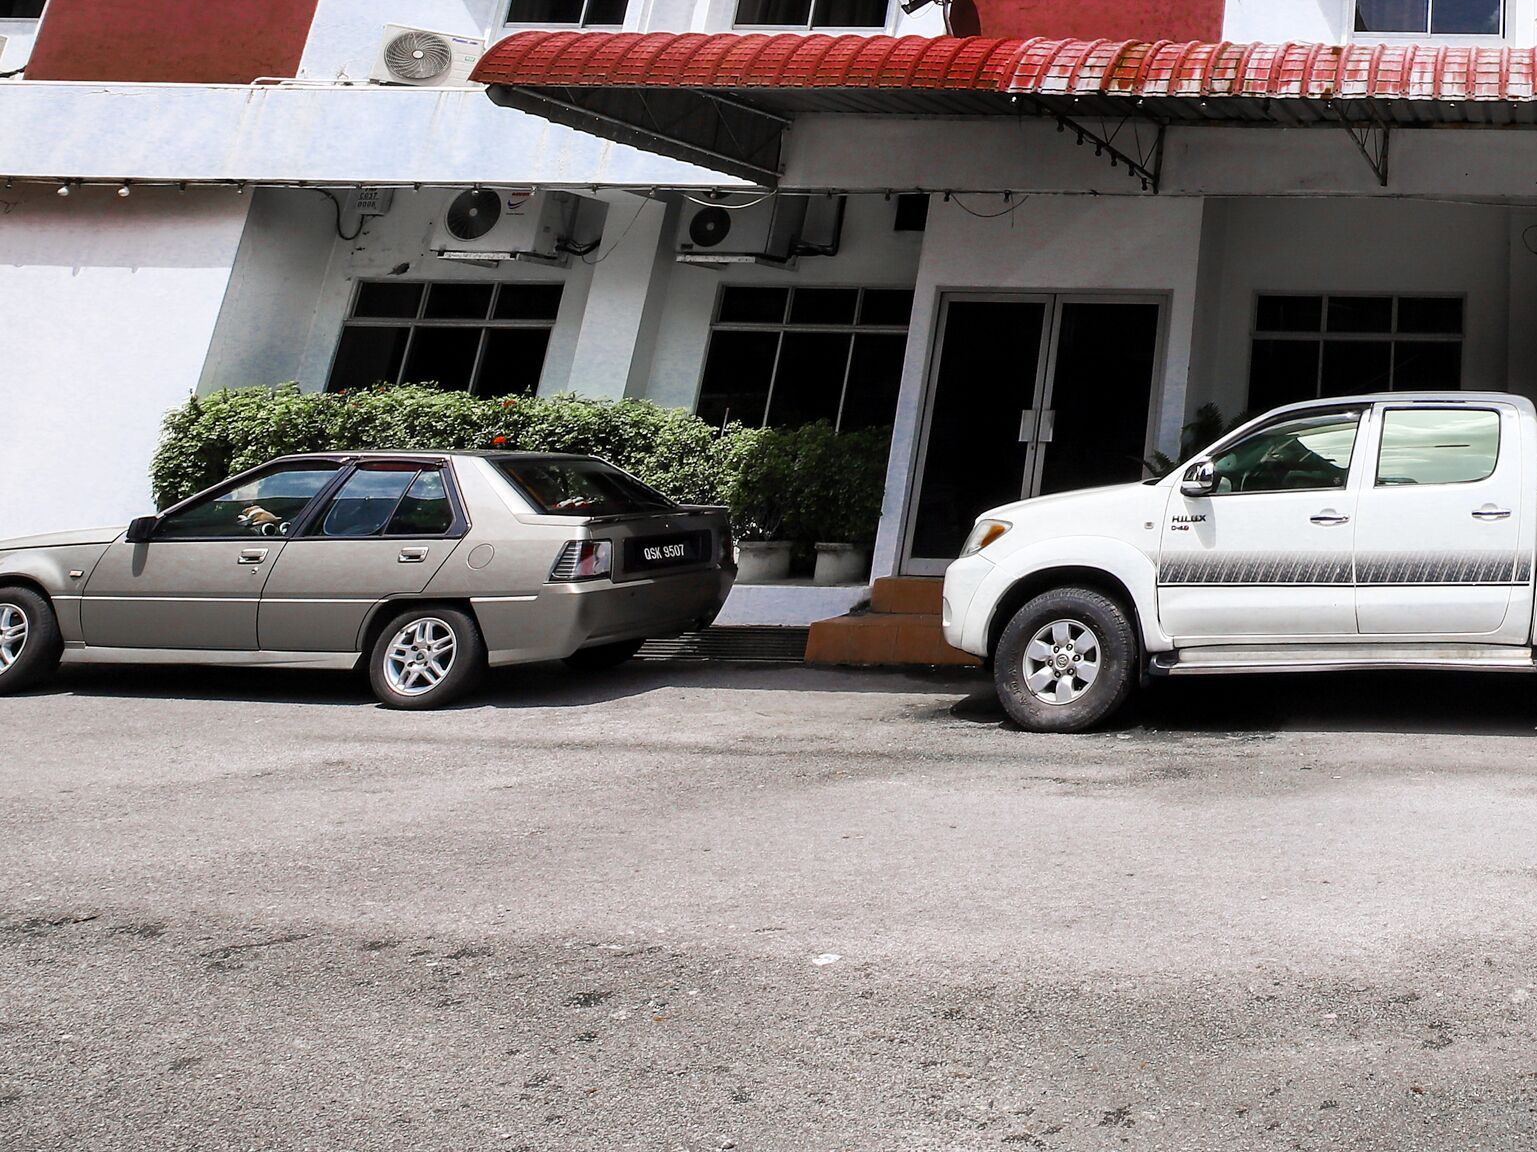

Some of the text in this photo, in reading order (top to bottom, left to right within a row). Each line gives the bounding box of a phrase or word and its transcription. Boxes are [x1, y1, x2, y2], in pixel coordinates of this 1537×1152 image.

[1172, 514, 1207, 523] HILUX
[644, 543, 685, 560] QSK 9507
